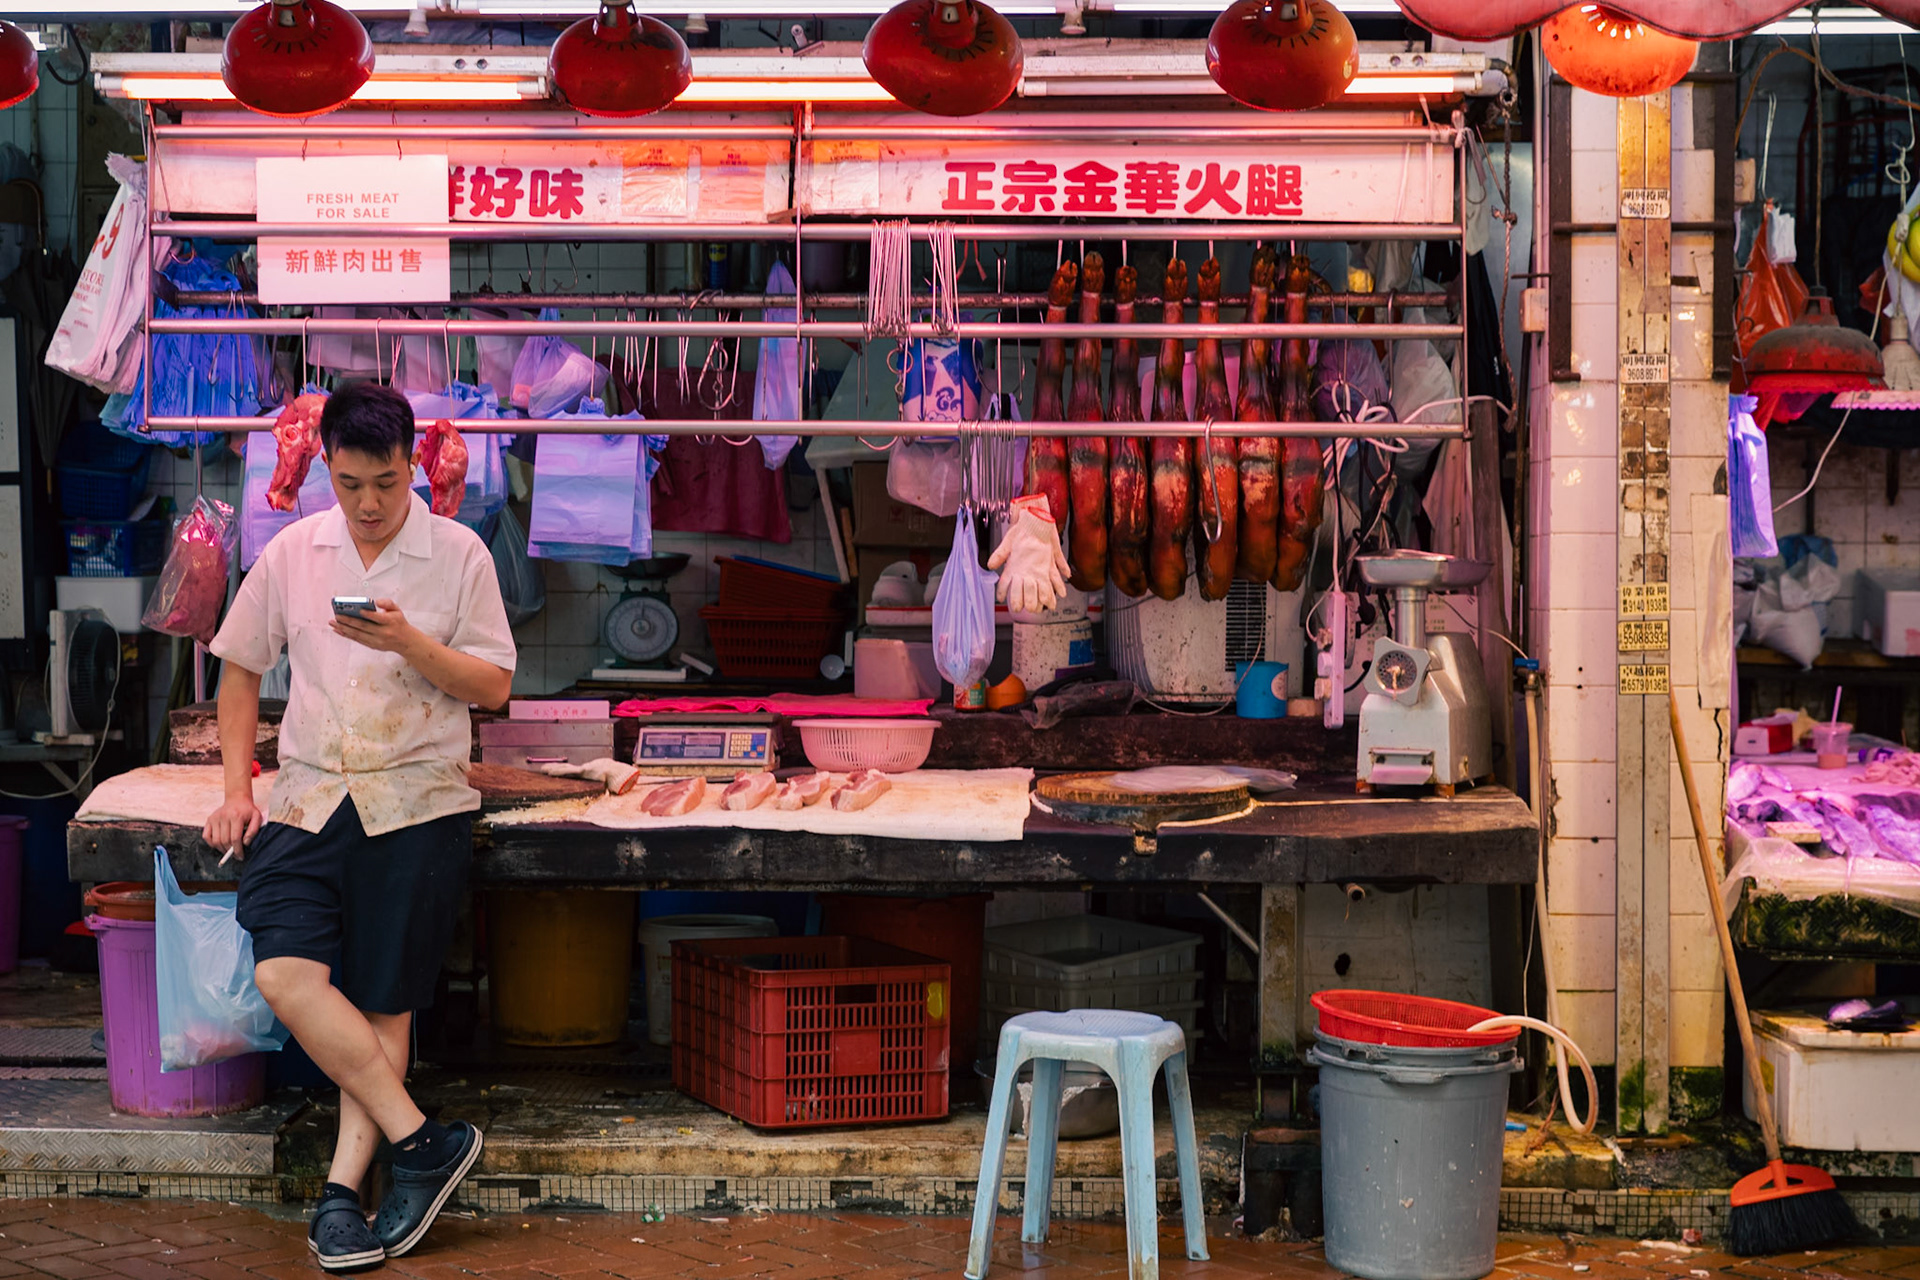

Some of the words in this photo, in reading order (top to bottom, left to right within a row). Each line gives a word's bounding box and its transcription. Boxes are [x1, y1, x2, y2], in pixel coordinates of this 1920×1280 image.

[941, 159, 1303, 217] 正宗金華火腿
[306, 192, 354, 205] FRESH
[361, 192, 400, 204] MEAT
[316, 207, 346, 219] FOR
[353, 207, 391, 219] SALE
[285, 247, 423, 274] 新鮮肉出售
